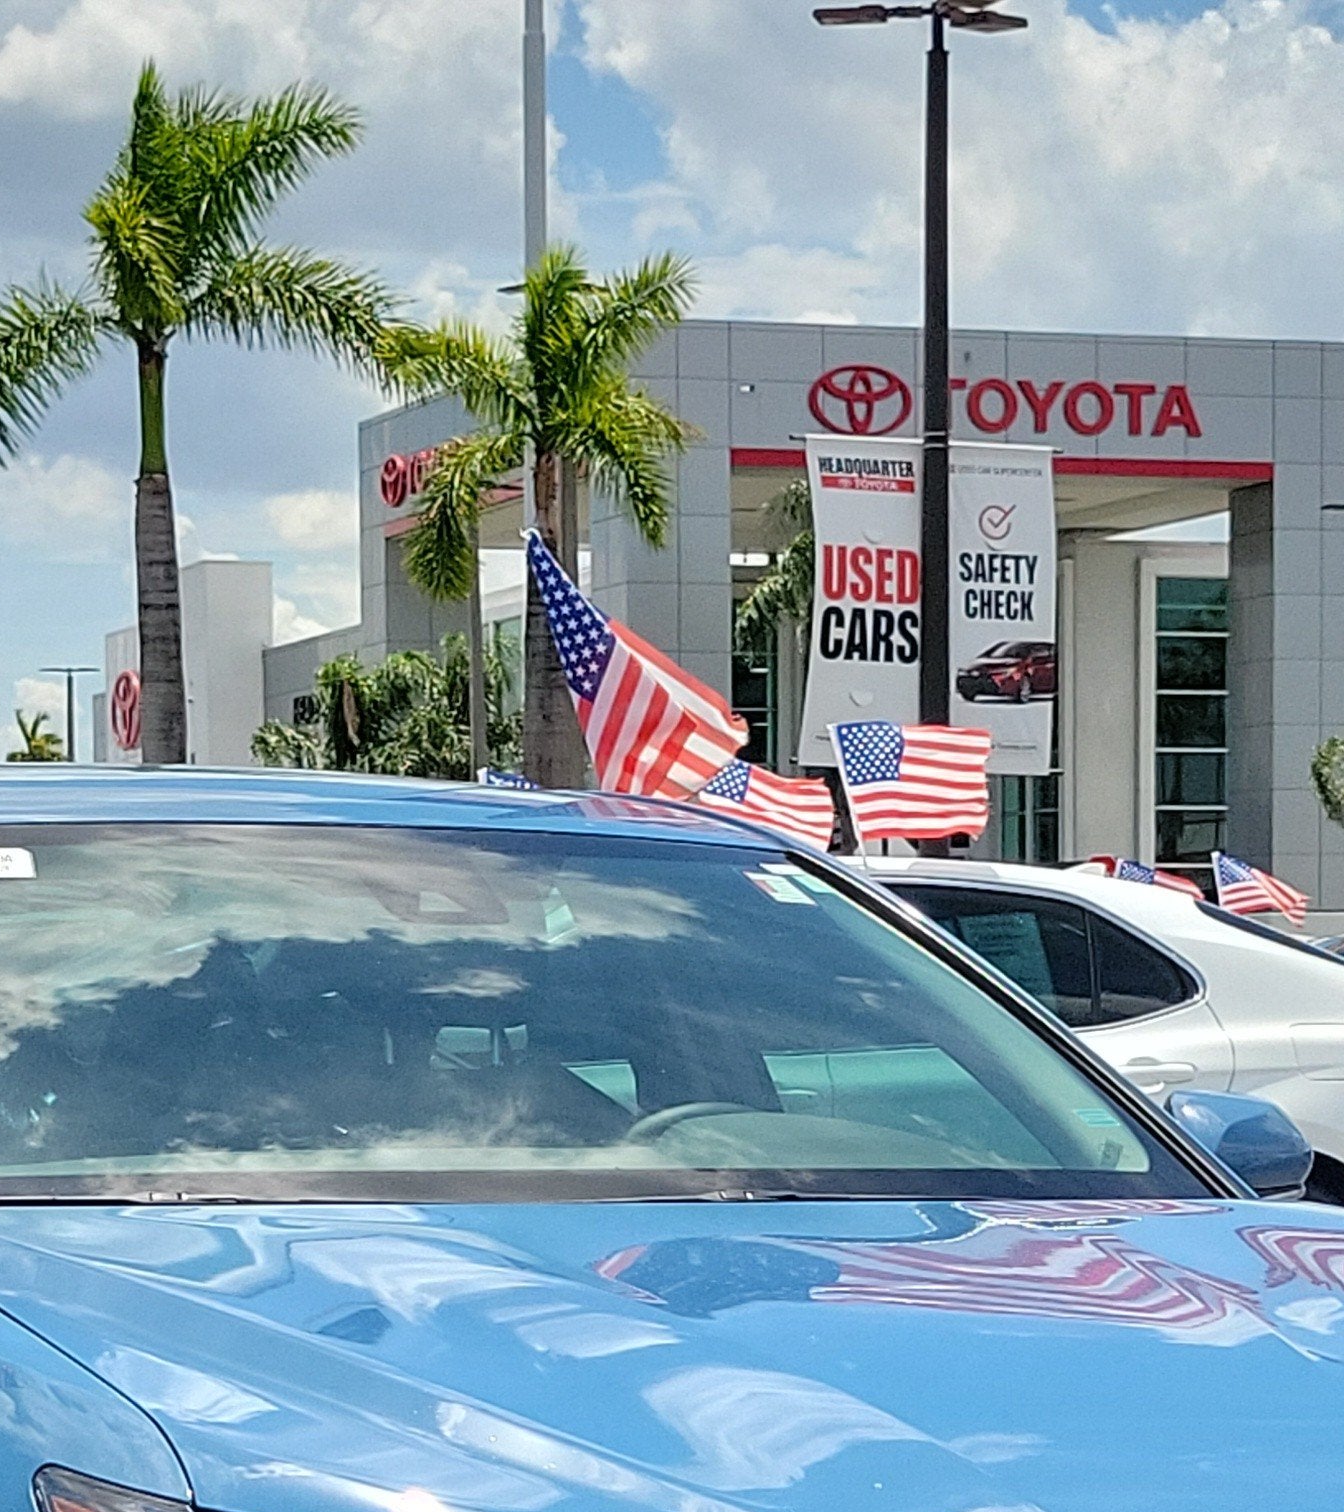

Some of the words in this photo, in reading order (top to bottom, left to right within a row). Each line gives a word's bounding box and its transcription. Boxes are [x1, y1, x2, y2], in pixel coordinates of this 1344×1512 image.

[817, 456, 915, 478] HEADQUARTER
[852, 478, 898, 491] TOYOTA
[822, 544, 919, 604] USED
[958, 552, 1038, 585] SAFETY
[964, 588, 1034, 622] CHECK
[819, 605, 919, 665] CARS
